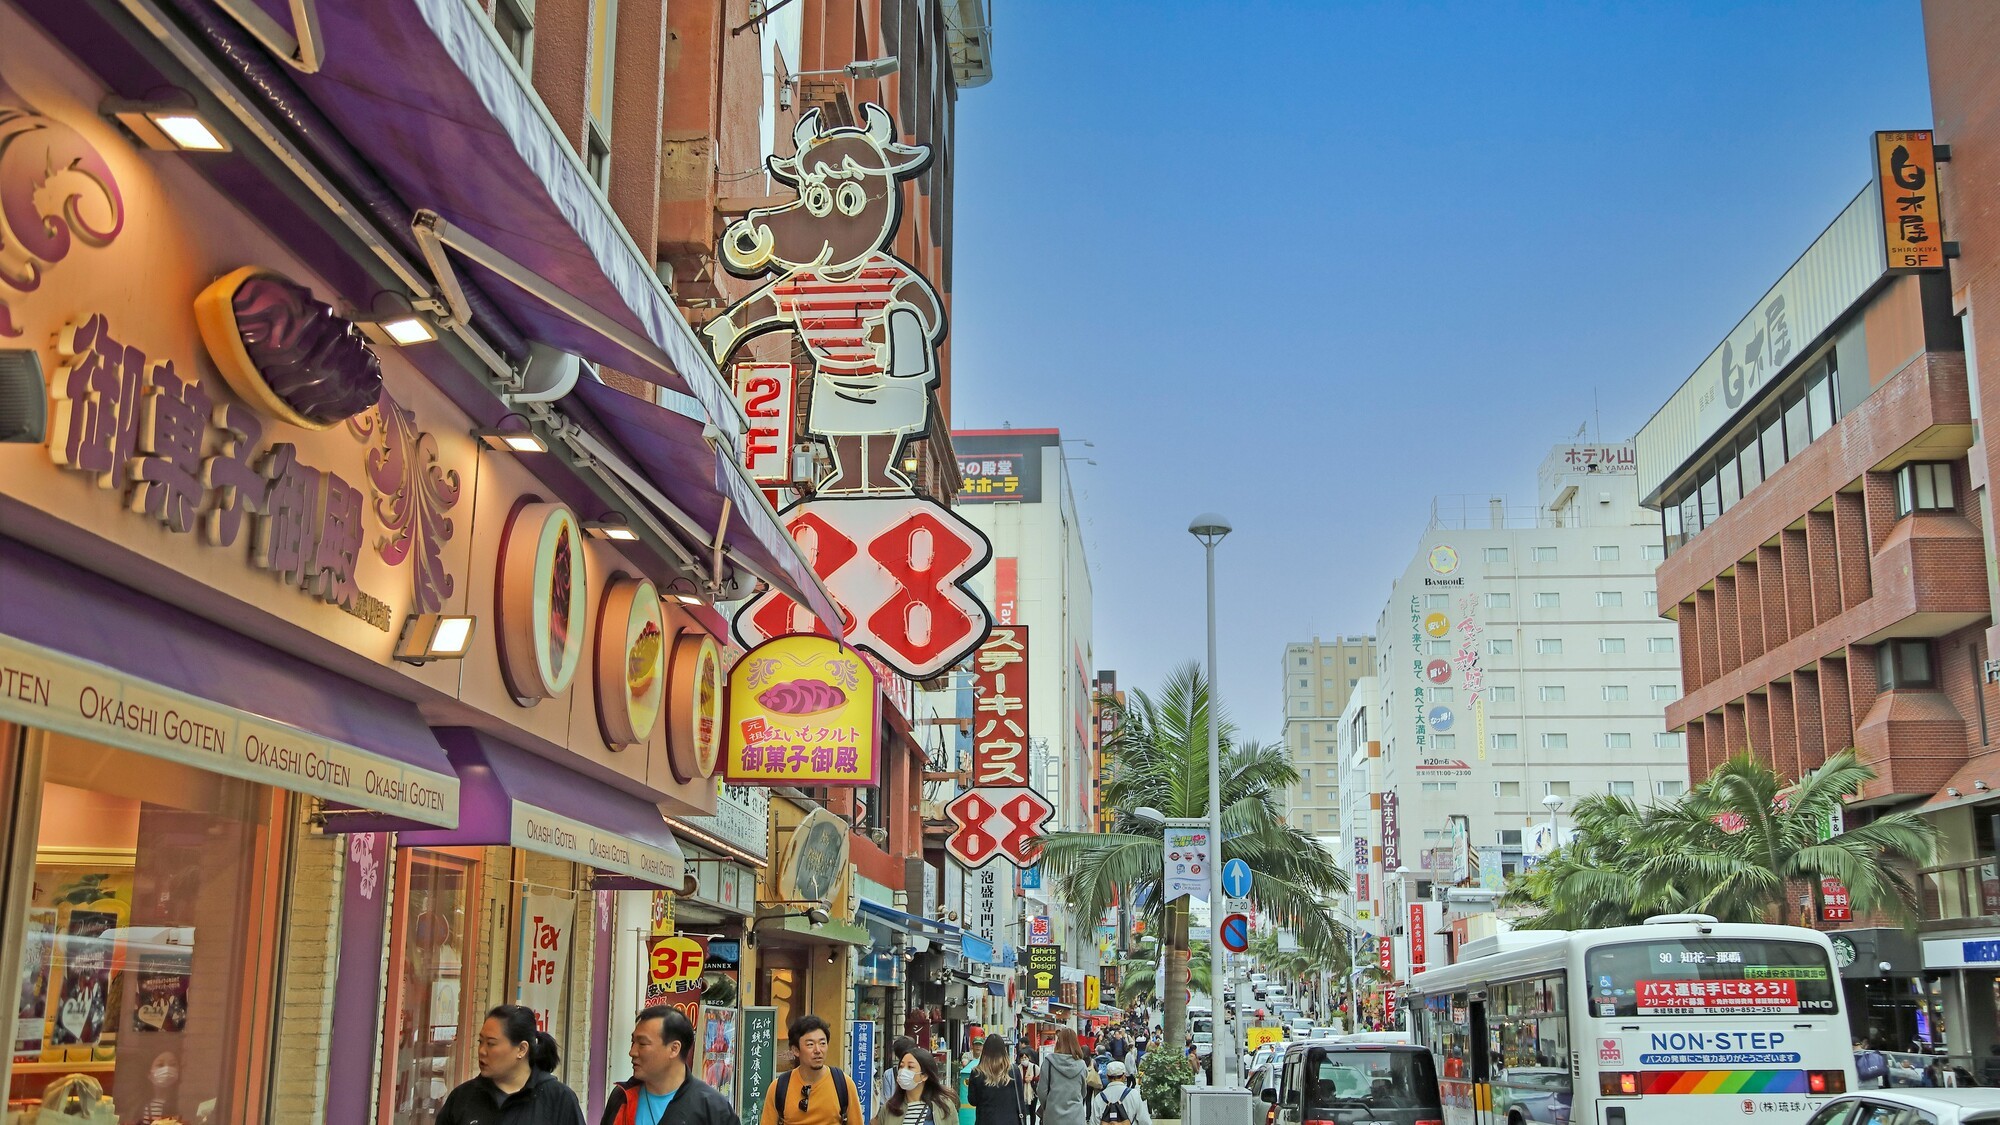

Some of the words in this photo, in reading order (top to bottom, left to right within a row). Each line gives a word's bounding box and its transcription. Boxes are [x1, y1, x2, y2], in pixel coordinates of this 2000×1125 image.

[1905, 255, 1928, 266] 5F
[745, 377, 781, 470] 2F
[51, 313, 365, 606] 御菓子御殿
[1565, 447, 1634, 464] ホテル山
[957, 477, 1019, 493] キホーテ
[0, 667, 50, 707] TEN
[80, 686, 158, 736] OKASHI
[164, 710, 225, 754] GOTEN
[978, 629, 1025, 783] ステーキハウス
[763, 725, 860, 742] 紅いもタルト
[245, 735, 302, 775] OKASHI
[305, 752, 350, 788] GOTEN
[741, 745, 858, 774] 御菓子御殿
[365, 769, 408, 803] OKASHI
[410, 782, 445, 811] GOTEN
[950, 793, 1046, 867] 88
[1384, 806, 1396, 867] ホテル山の内
[1033, 918, 1048, 934] 薬
[1828, 909, 1845, 917] 2F
[533, 916, 561, 951] Tax
[652, 947, 702, 979] 3F
[1660, 953, 1673, 963] 90
[1644, 983, 1788, 996] バス運転手になろう!
[1652, 1033, 1785, 1050] NON-STEP
[1646, 1054, 1795, 1063] バスの発車にご協力ありがとうございます
